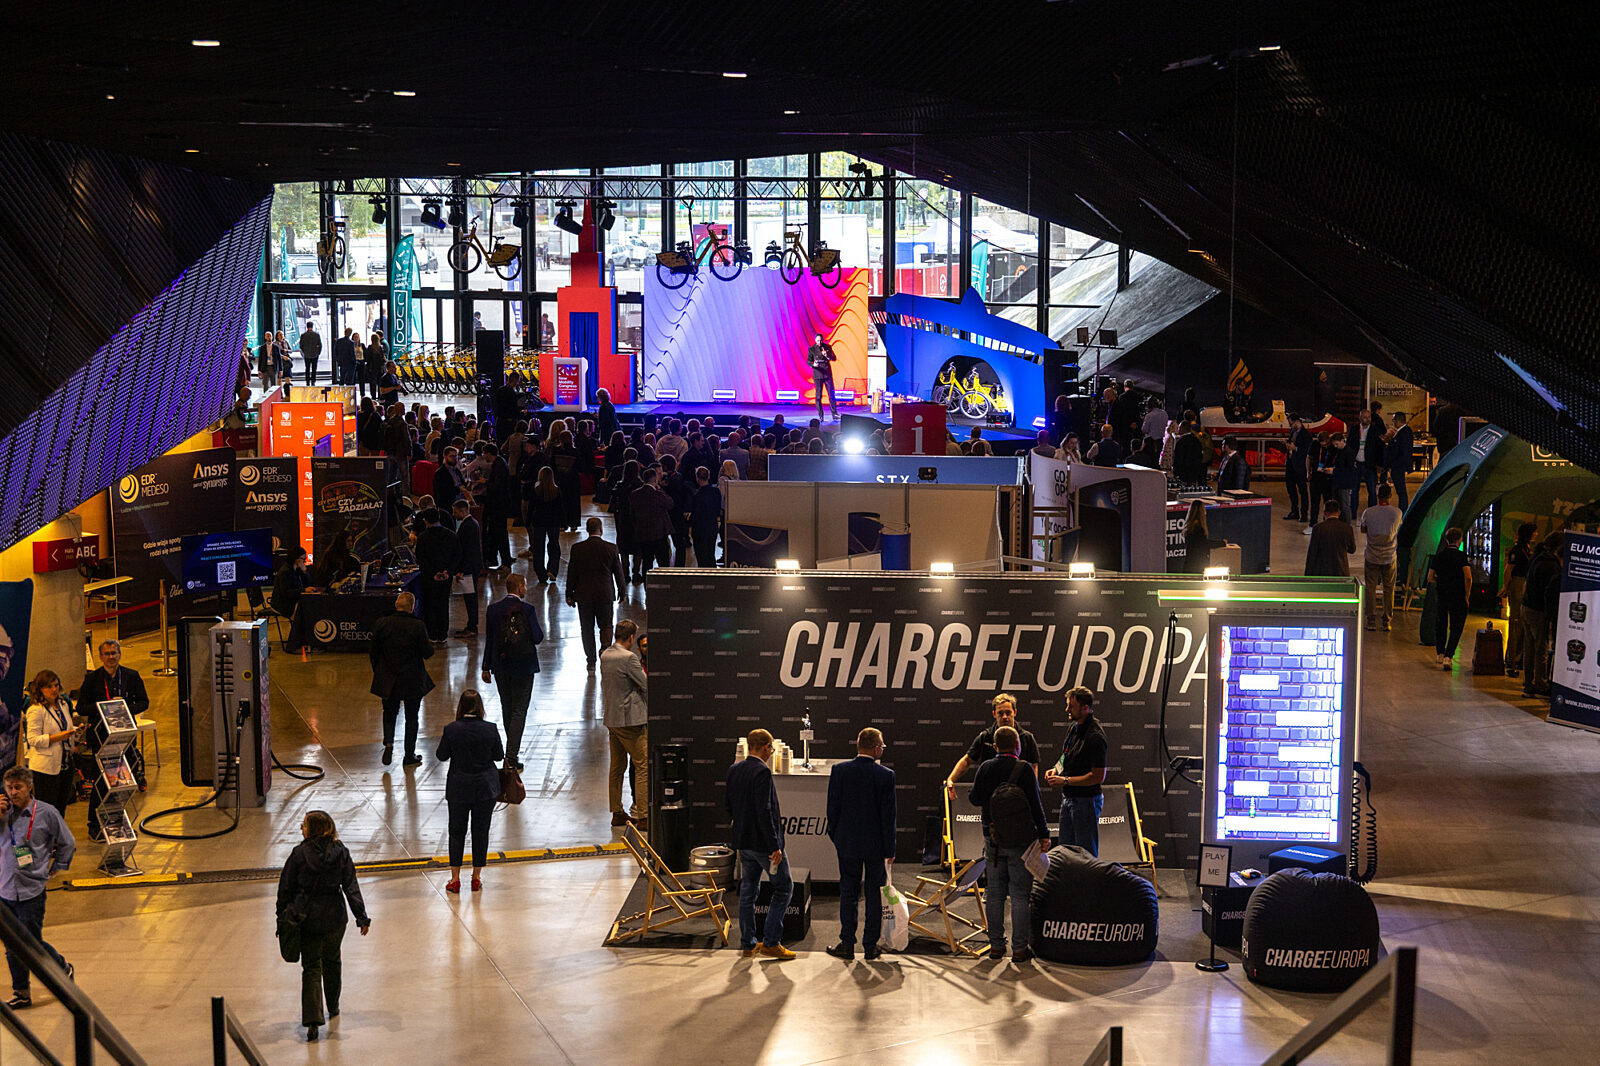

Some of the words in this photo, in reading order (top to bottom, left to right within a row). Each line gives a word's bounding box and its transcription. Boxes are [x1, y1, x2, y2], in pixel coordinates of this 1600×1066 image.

[1391, 388, 1413, 396] world
[193, 463, 230, 479] Ansys
[262, 466, 278, 475] EDR
[141, 473, 156, 486] EDR
[262, 474, 293, 483] MEDESO
[876, 474, 910, 484] STX
[141, 483, 170, 498] MEDESO
[245, 490, 289, 503] Ansys
[337, 497, 354, 506] CZY
[76, 544, 97, 559] ABC
[1570, 542, 1585, 553] EU
[1166, 548, 1187, 558] ACZ
[339, 621, 357, 631] EDR
[339, 631, 374, 641] MEDESO
[779, 620, 1208, 694] CHARGEEUROPA
[1205, 852, 1226, 860] PLAY
[1207, 868, 1220, 876] ME
[1042, 919, 1145, 942] CHARGEEUROPA
[1264, 948, 1370, 969] CHARGEEUROPA
